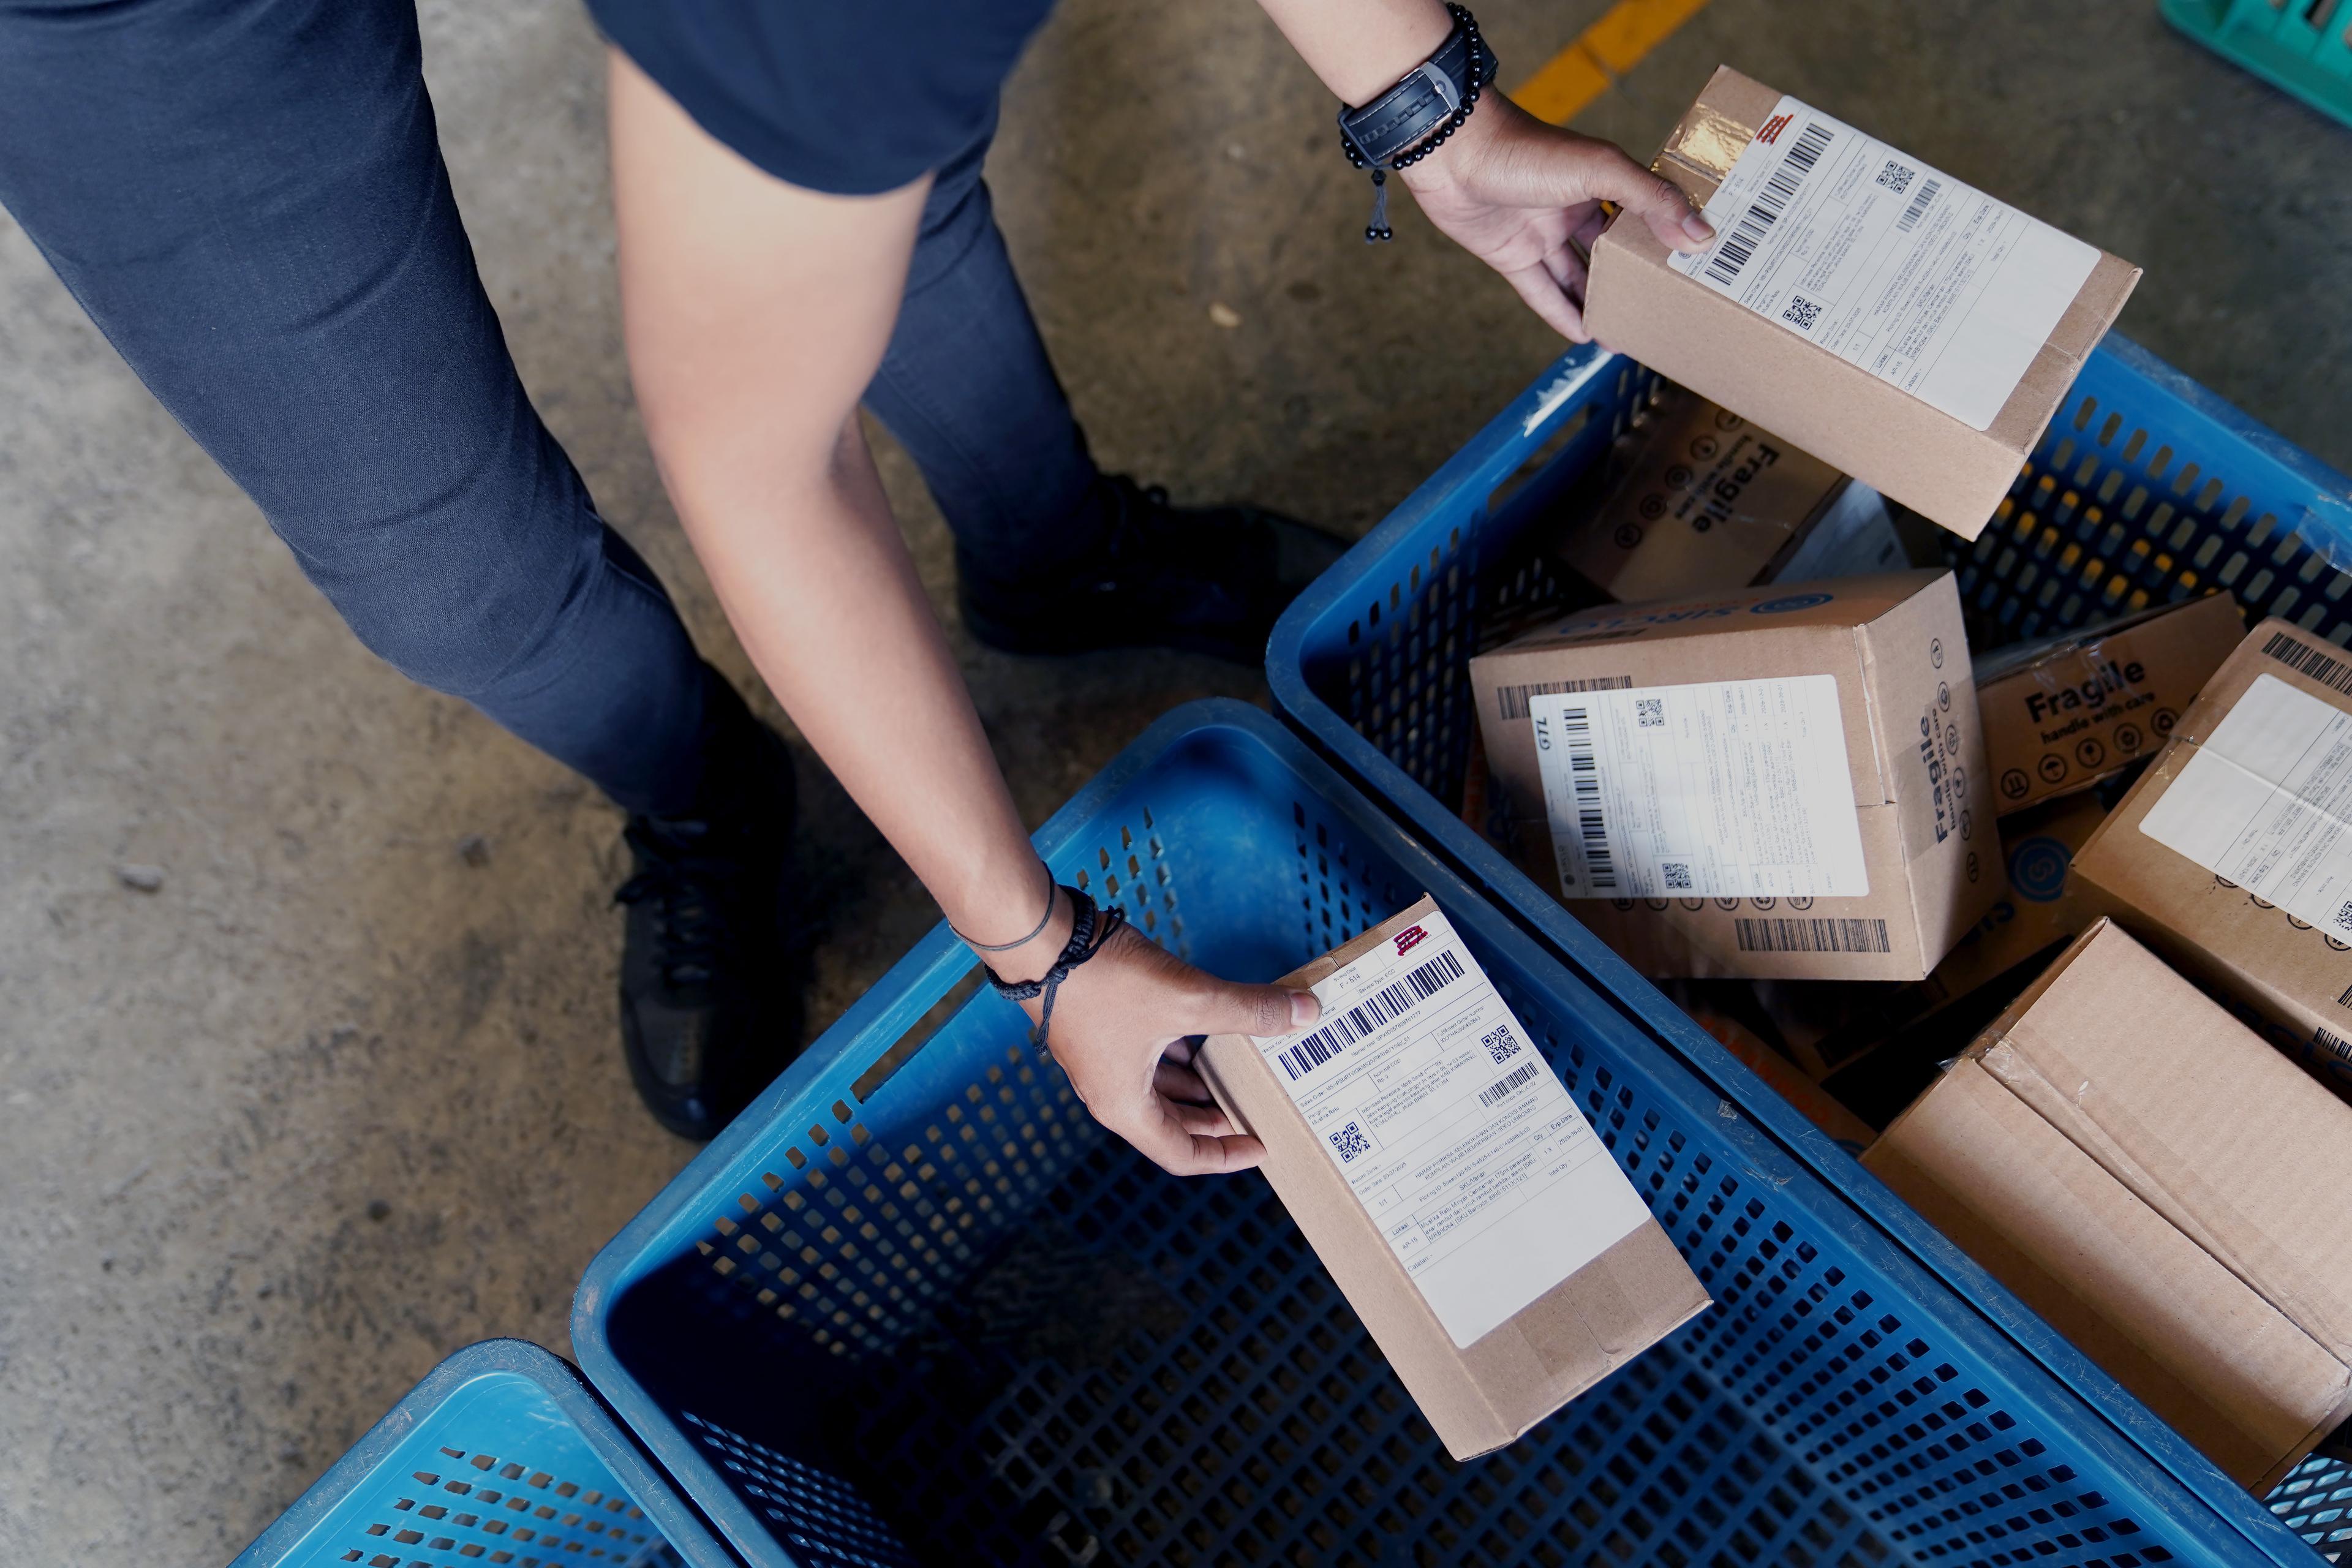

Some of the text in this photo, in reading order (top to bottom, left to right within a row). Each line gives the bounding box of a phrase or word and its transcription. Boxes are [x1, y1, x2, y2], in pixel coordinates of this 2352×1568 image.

[1692, 442, 1780, 533] Fragile
[2024, 660, 2145, 723] Fragile
[2041, 692, 2156, 744] handle with care
[1920, 715, 1948, 844] Fragile
[1932, 708, 1956, 831] handle with care
[1349, 973, 1361, 984] 514
[1358, 981, 1375, 995] Service
[1456, 1014, 1470, 1026] Order
[1468, 1003, 1486, 1019] Number
[1373, 1057, 1402, 1079] Nominal COD
[1299, 1096, 1314, 1109] Sales
[1311, 1104, 1340, 1126] Mustika Ratu
[1549, 1112, 1573, 1131] Exp Date
[1414, 1095, 1539, 1179] HARAP PERIKSA KELENGKAPAN DAN KONDISI BARANG
[1423, 1103, 1537, 1182] KOMPLAIN WAJIB MEMBERIKAN VIDEO UNBOXING
[1532, 1131, 1544, 1142] Qty
[1351, 1171, 1367, 1185] Return
[1458, 1169, 1487, 1191] SKU/Varian
[1548, 1166, 1560, 1177] Total
[1358, 1184, 1373, 1196] Order
[1418, 1187, 1437, 1204] Picking
[1420, 1212, 1441, 1229] Mustika
[1438, 1204, 1453, 1217] Ratu
[1450, 1193, 1470, 1210] Minyak
[1508, 1150, 1534, 1171] perawatan
[1434, 1212, 1454, 1228] rambut
[1452, 1205, 1464, 1217] dan
[1474, 1186, 1493, 1202] rambut
[1491, 1174, 1512, 1191] berkilau
[1509, 1165, 1525, 1178] alami
[1377, 1197, 1388, 1208] 1/1
[1391, 1220, 1410, 1236] Lokasi
[1400, 1235, 1419, 1250] AP-15
